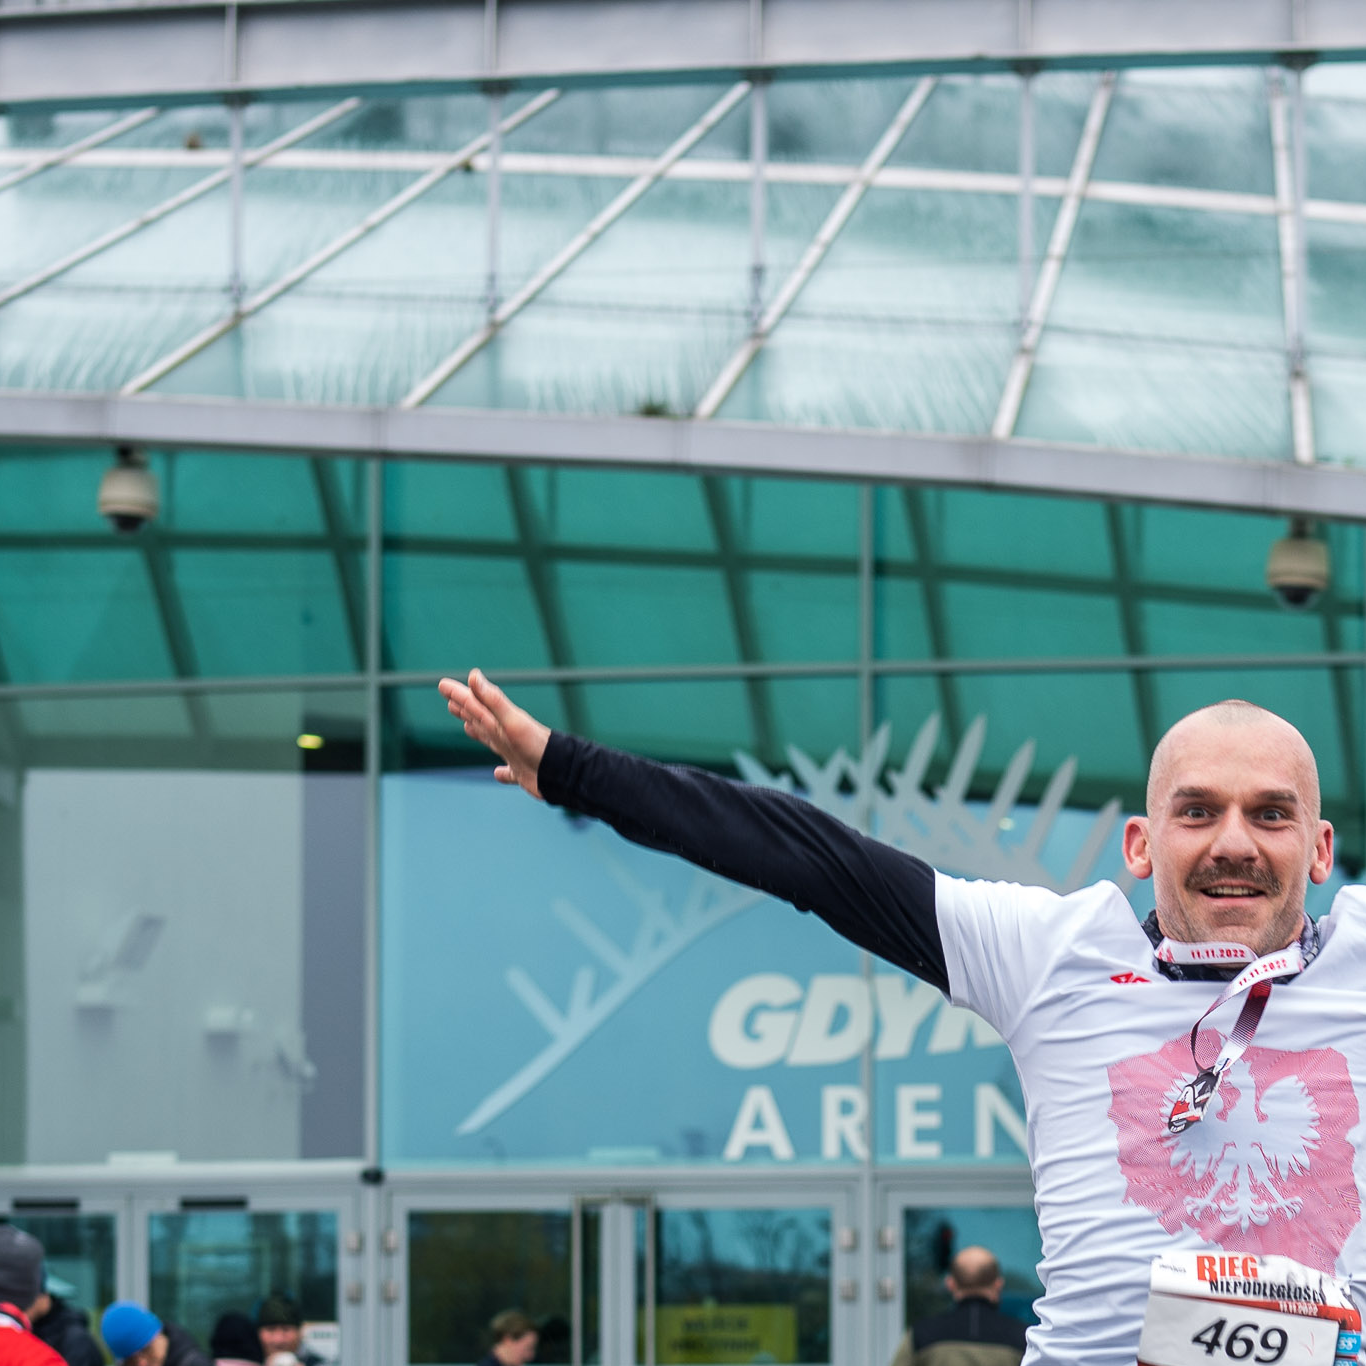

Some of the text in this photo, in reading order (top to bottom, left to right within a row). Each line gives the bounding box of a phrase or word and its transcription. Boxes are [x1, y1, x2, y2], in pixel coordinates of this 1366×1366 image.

[1191, 948, 1245, 959] 11.11.2022
[1239, 959, 1287, 986] 11.11.2022
[723, 1083, 1031, 1160] AREN
[1197, 1255, 1258, 1281] BIEG
[1191, 1316, 1289, 1364] 469
